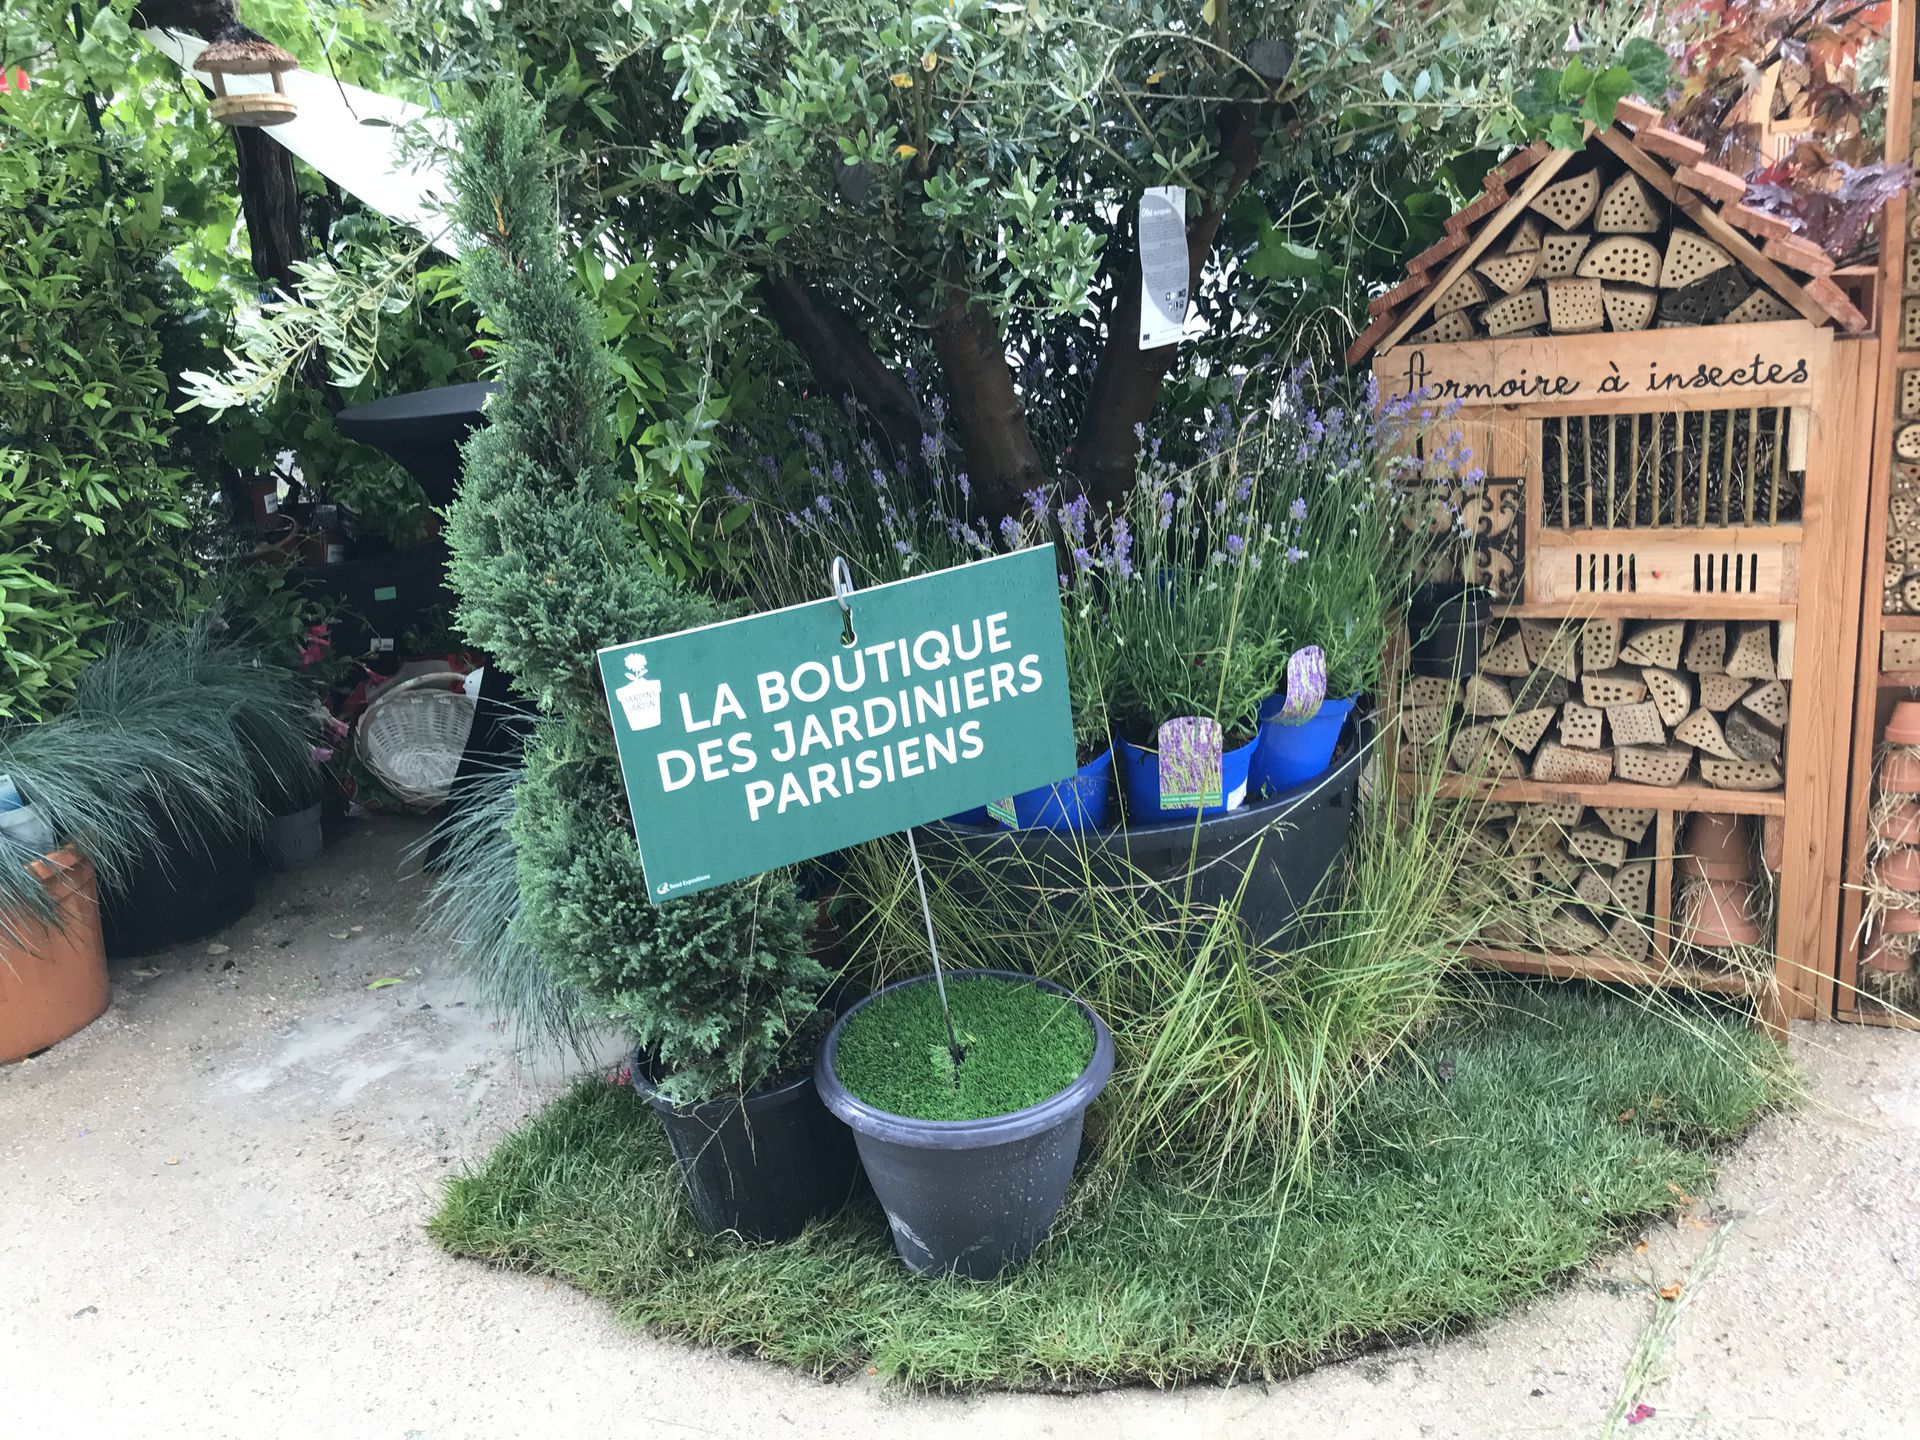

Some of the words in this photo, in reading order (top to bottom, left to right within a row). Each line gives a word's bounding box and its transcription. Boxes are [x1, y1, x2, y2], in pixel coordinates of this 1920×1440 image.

[1394, 350, 1580, 400] Armoire
[1597, 360, 1629, 393] à
[1646, 353, 1808, 391] insectes
[657, 731, 758, 793] DES
[770, 653, 1043, 762] JARDINIERS
[679, 682, 747, 733] LA
[756, 611, 1012, 714] BOUTIQUE
[745, 720, 984, 822] PARISIENS
